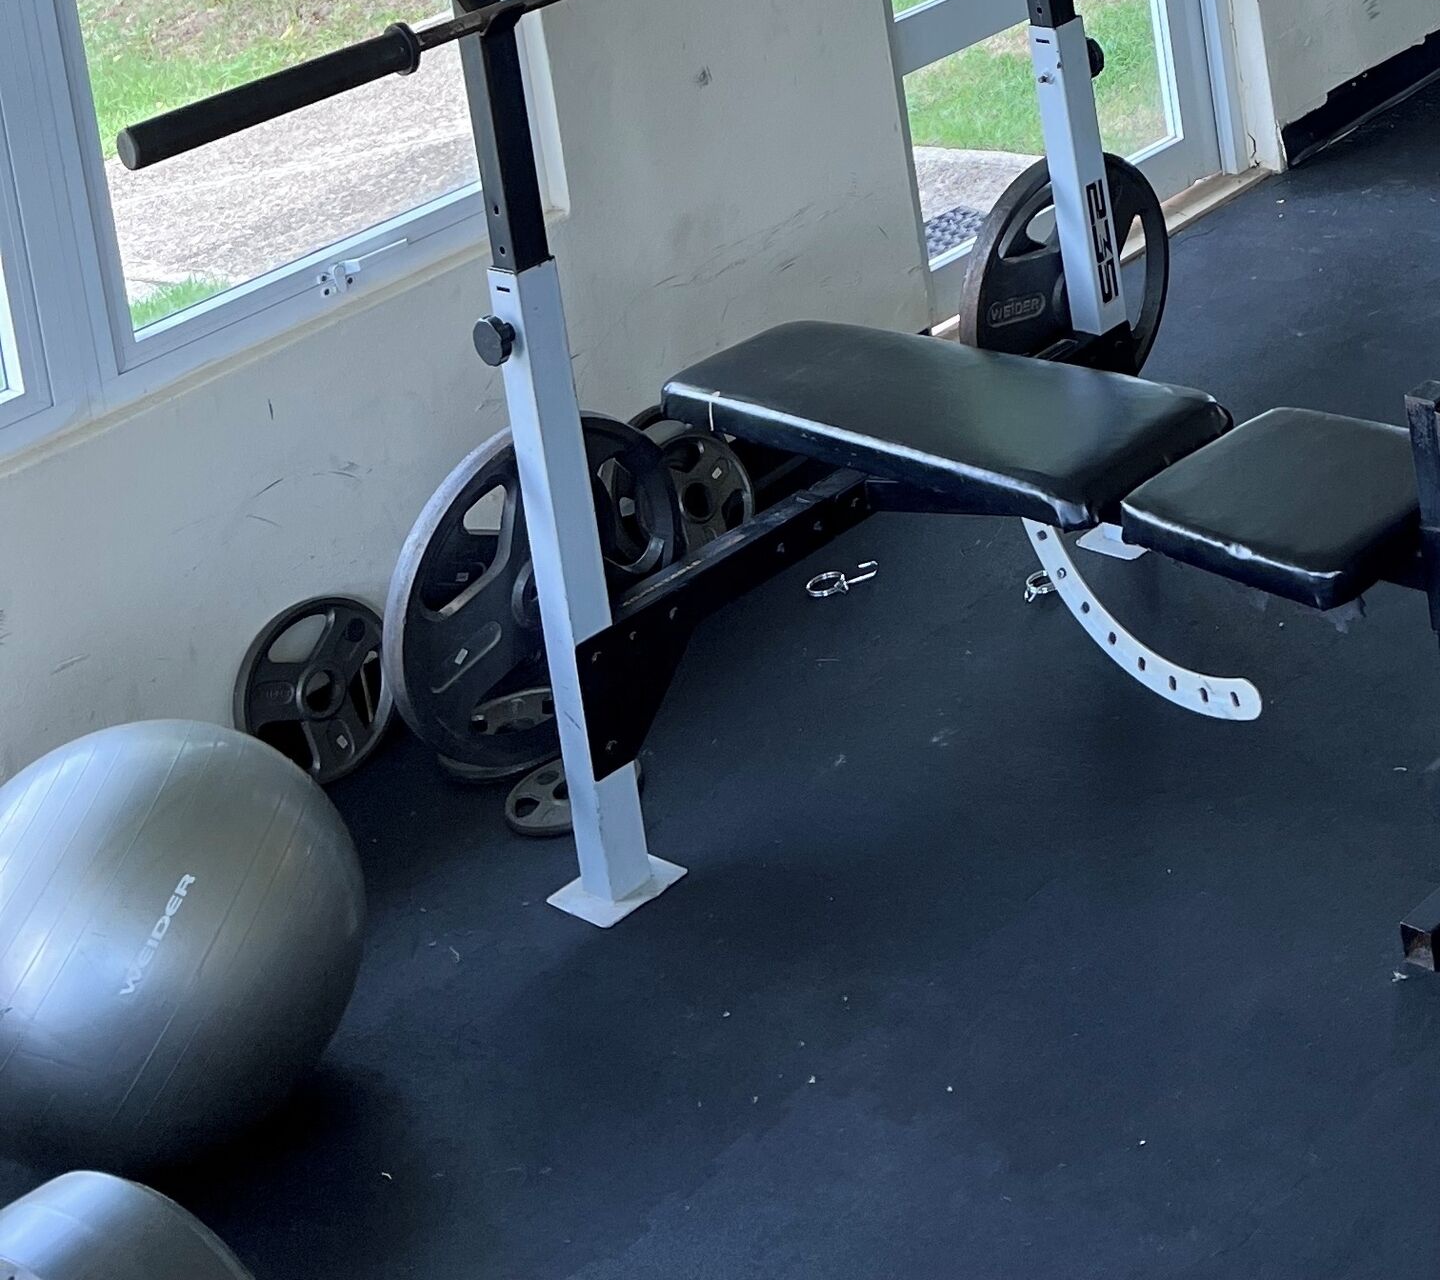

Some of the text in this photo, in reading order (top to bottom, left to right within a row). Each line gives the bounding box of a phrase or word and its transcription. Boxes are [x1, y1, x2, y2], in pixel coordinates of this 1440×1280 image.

[1086, 178, 1119, 304] 235
[991, 296, 1041, 322] WEIDER
[119, 873, 196, 995] WEIDER
